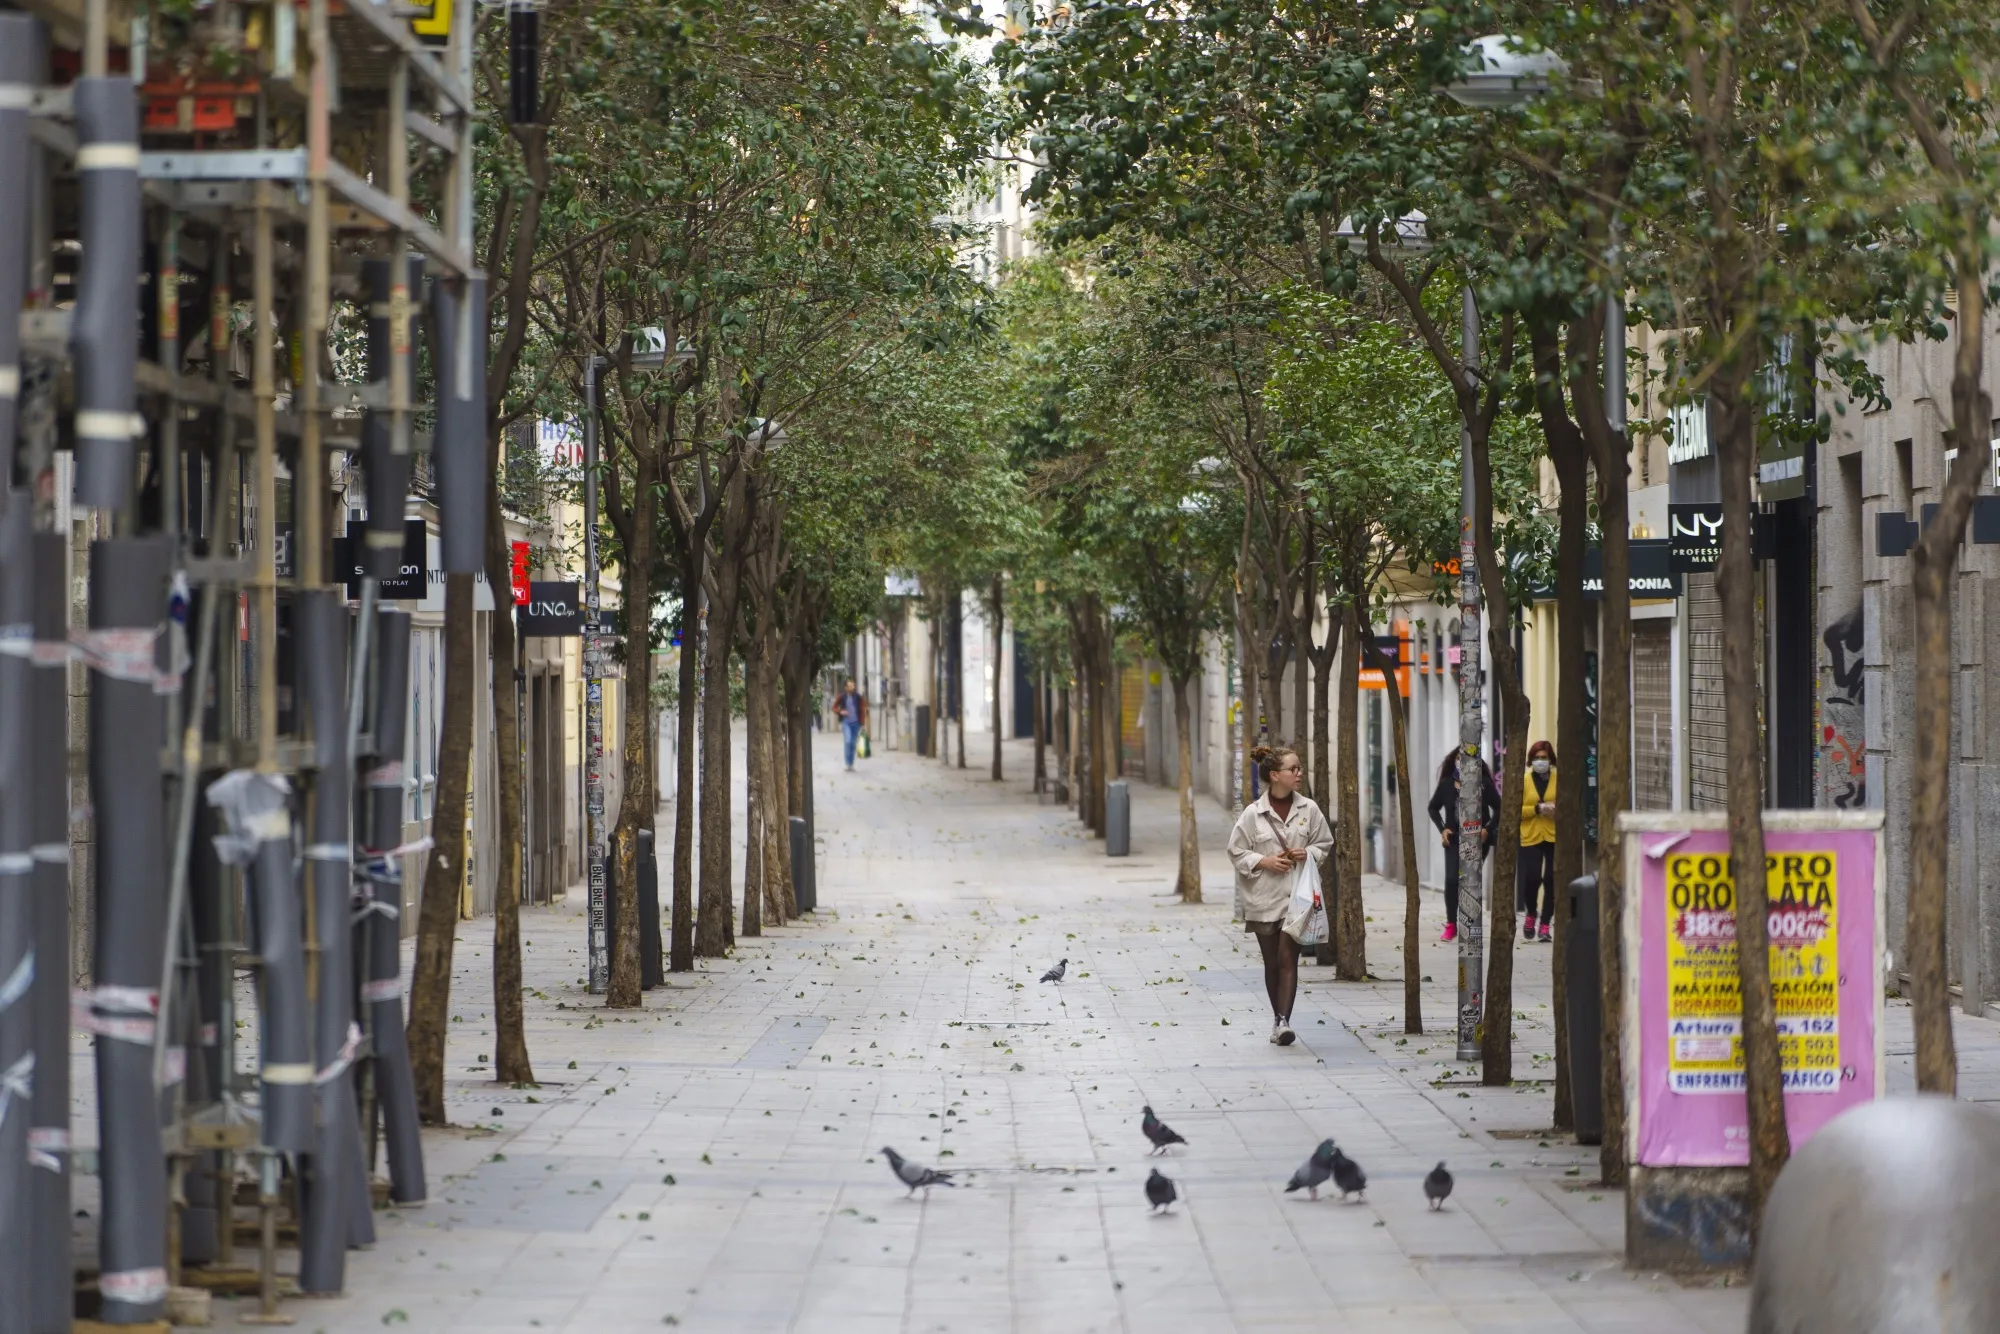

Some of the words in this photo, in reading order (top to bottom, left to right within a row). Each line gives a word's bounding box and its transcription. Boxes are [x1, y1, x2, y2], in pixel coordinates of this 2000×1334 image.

[592, 866, 603, 884] BNE
[593, 888, 603, 906] BNE
[1672, 882, 1733, 911] ORO
[593, 910, 604, 928] BNE
[1673, 1021, 1734, 1034] Arturo
[1800, 1019, 1834, 1033] 162
